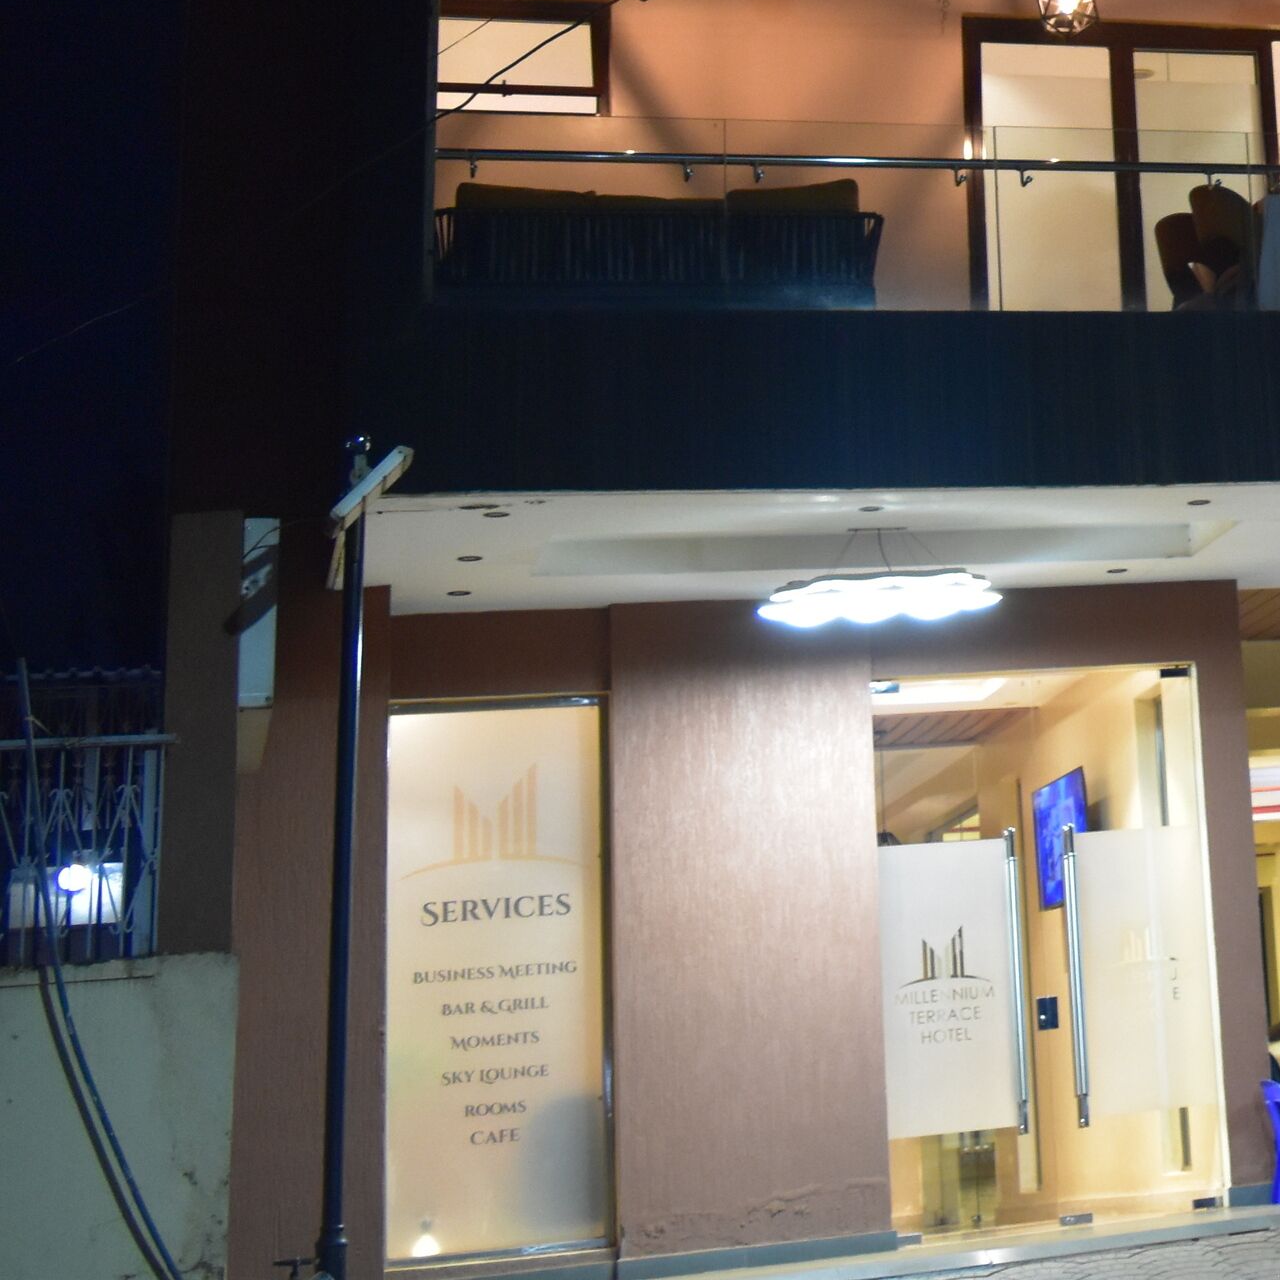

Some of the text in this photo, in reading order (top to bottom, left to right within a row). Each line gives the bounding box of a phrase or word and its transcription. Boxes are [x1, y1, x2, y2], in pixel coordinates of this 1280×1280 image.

[420, 893, 572, 927] SERVICES
[413, 961, 578, 984] BUSINESS MEETING
[441, 996, 549, 1016] BAR & GRILL
[449, 1031, 541, 1052] MOMENTS
[920, 1027, 973, 1044] HOTEL
[441, 1064, 550, 1086] SKY LOUNGE
[464, 1100, 527, 1117] ROOMS
[469, 1127, 521, 1145] CAFE
